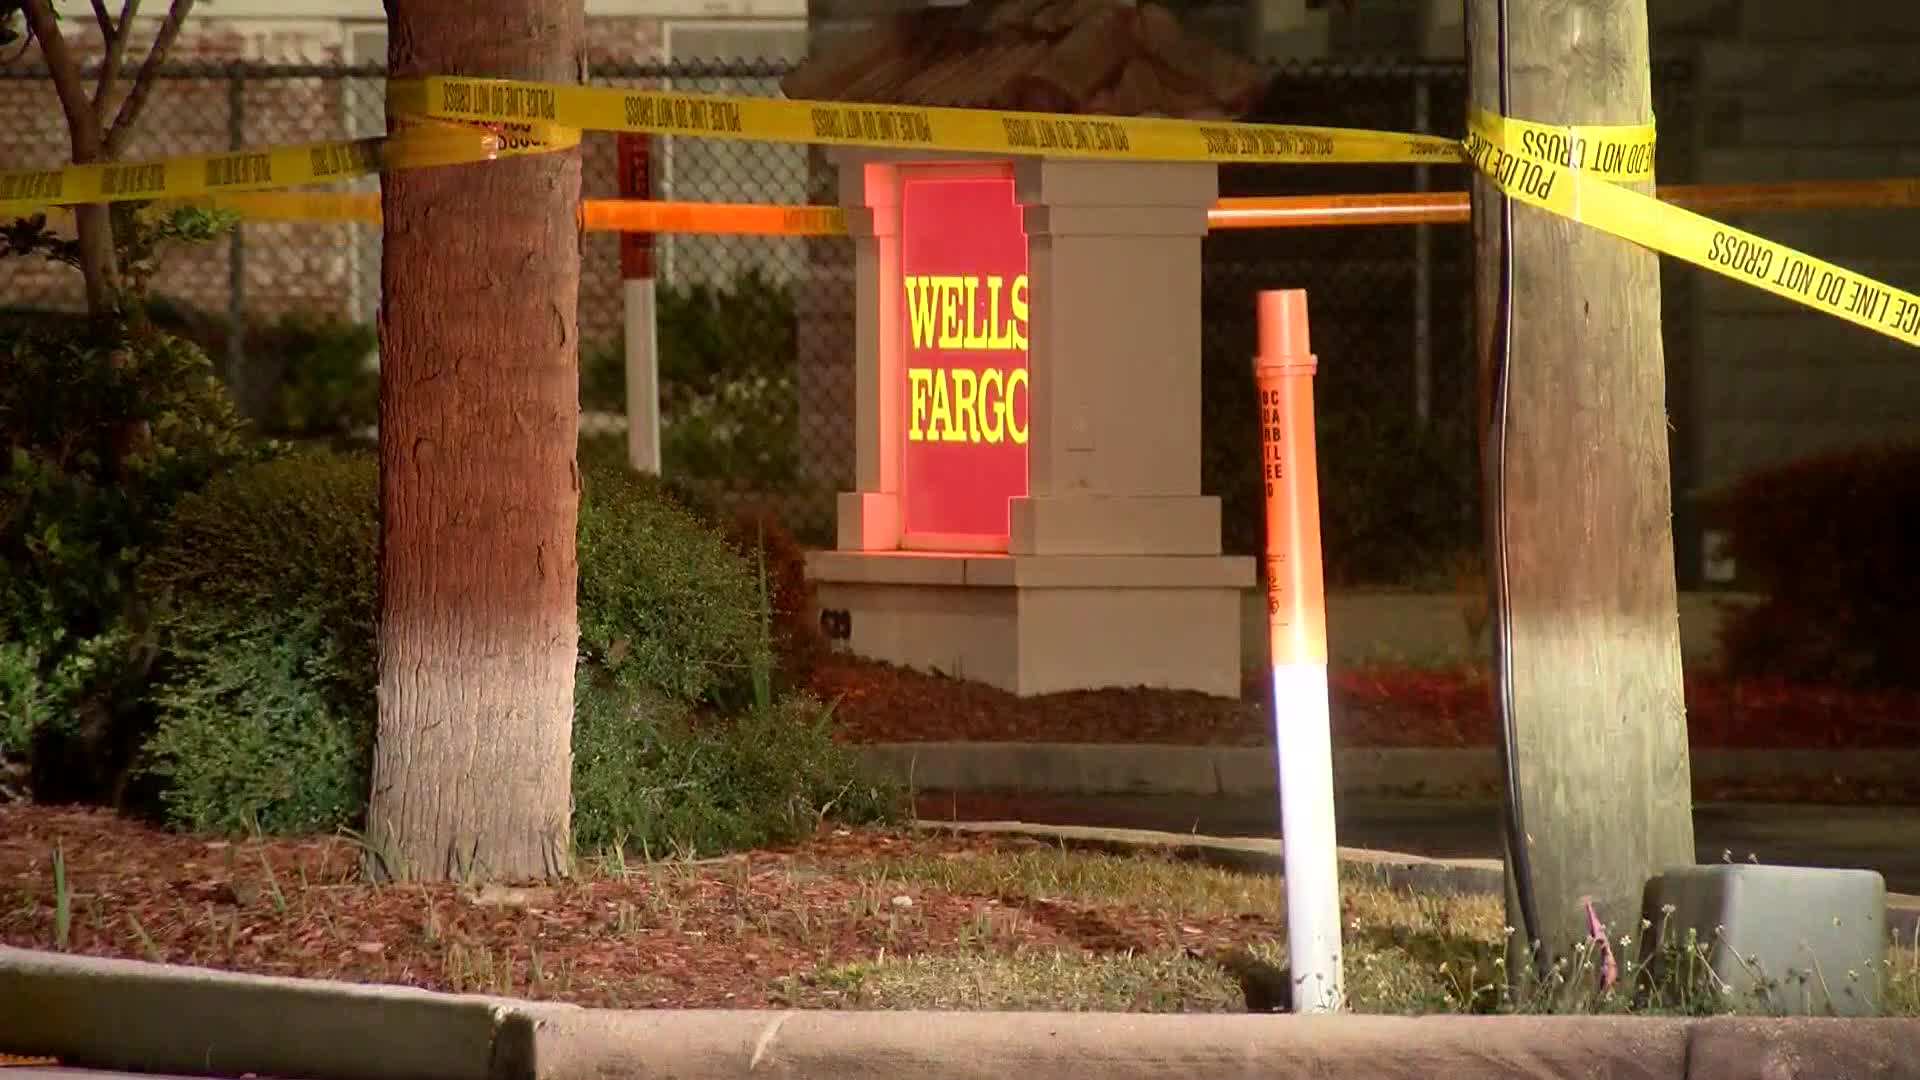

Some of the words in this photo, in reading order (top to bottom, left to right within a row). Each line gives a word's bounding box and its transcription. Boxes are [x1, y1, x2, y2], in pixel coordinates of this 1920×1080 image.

[443, 82, 471, 113] CROSS
[473, 84, 490, 115] NOT
[492, 86, 504, 117] DO
[505, 87, 525, 118] LINE
[526, 88, 555, 119] POLICE
[624, 96, 654, 127] CROSS
[711, 101, 743, 132] POLICE
[1522, 129, 1586, 169] CROSS
[1590, 142, 1625, 174] NOT
[1493, 148, 1556, 200] POLICE
[1707, 231, 1774, 279] CROSS
[1771, 255, 1817, 296] NOT
[1816, 271, 1846, 306] DO
[904, 274, 1028, 350] WELLS
[1844, 280, 1890, 323] LINE
[1270, 389, 1282, 479] CABLE
